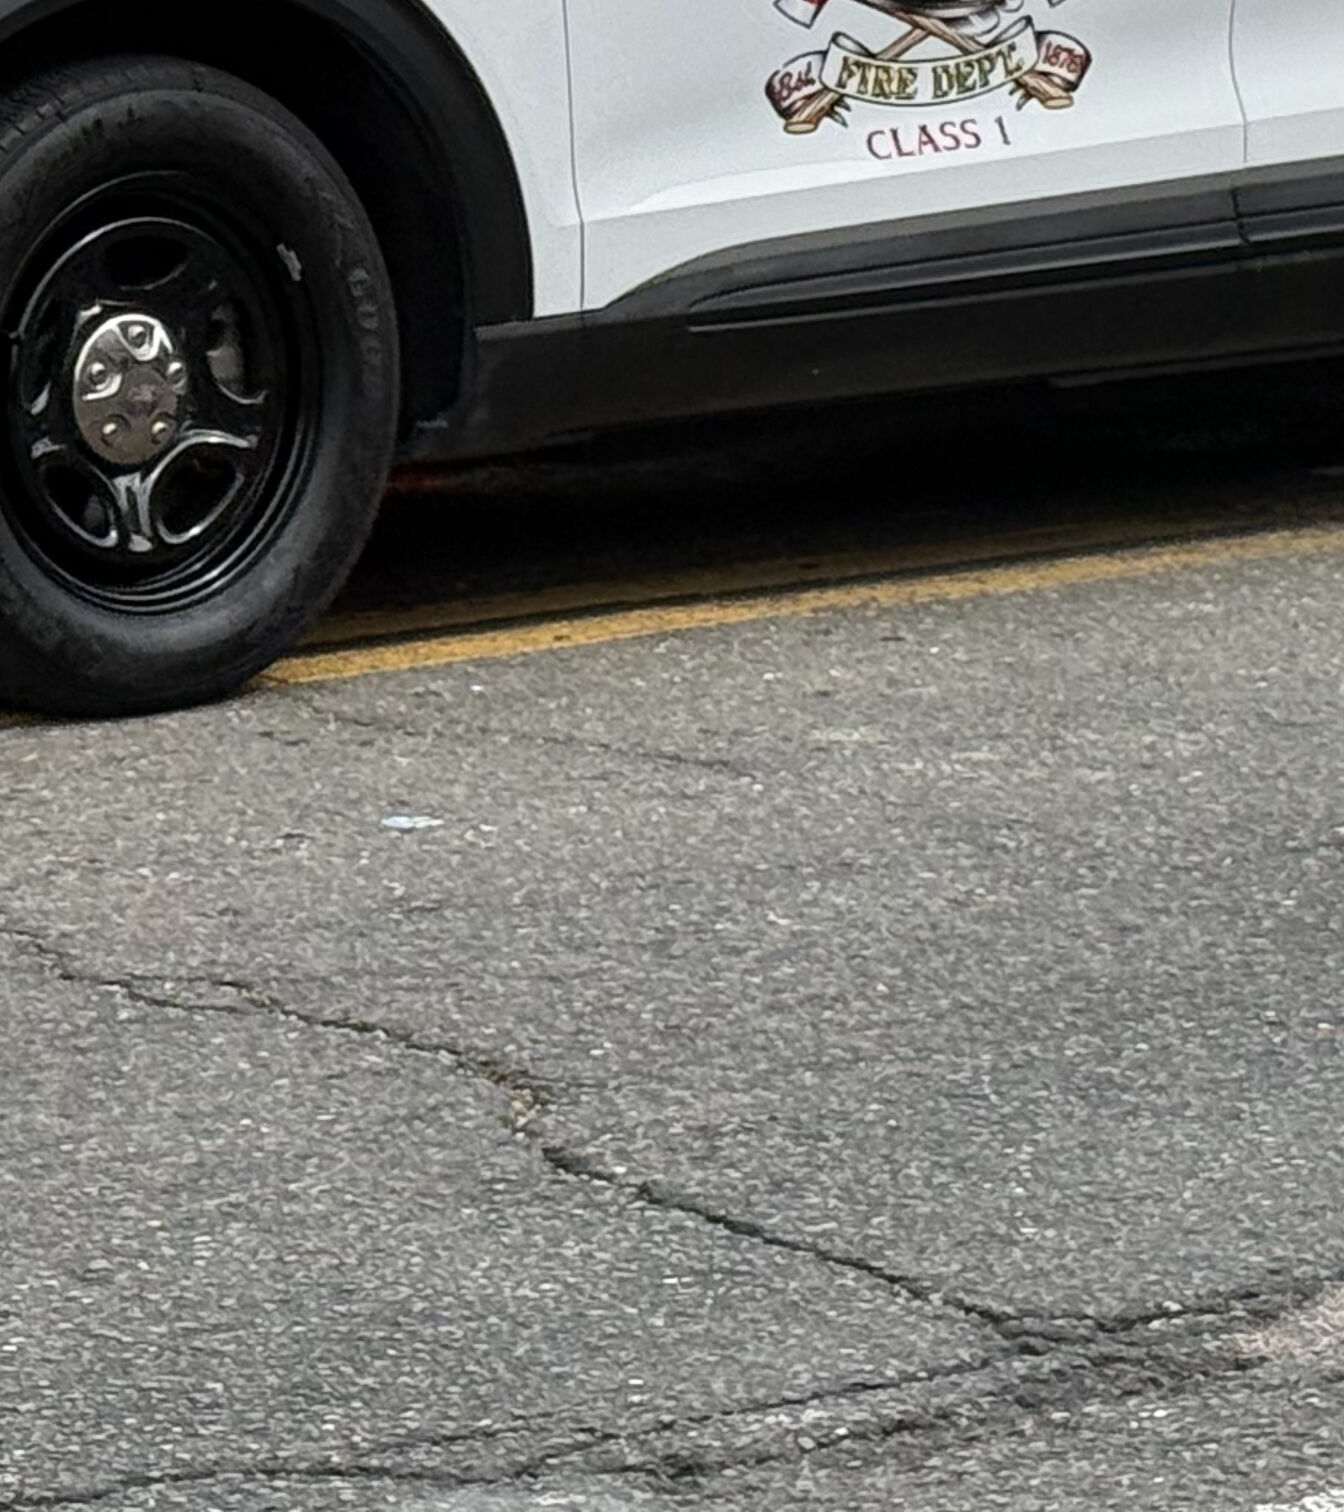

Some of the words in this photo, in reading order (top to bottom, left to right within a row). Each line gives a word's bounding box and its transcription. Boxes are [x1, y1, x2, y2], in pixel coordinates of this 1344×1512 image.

[835, 55, 919, 101] FIRE
[865, 119, 982, 161] CLASS
[994, 116, 1011, 146] 1
